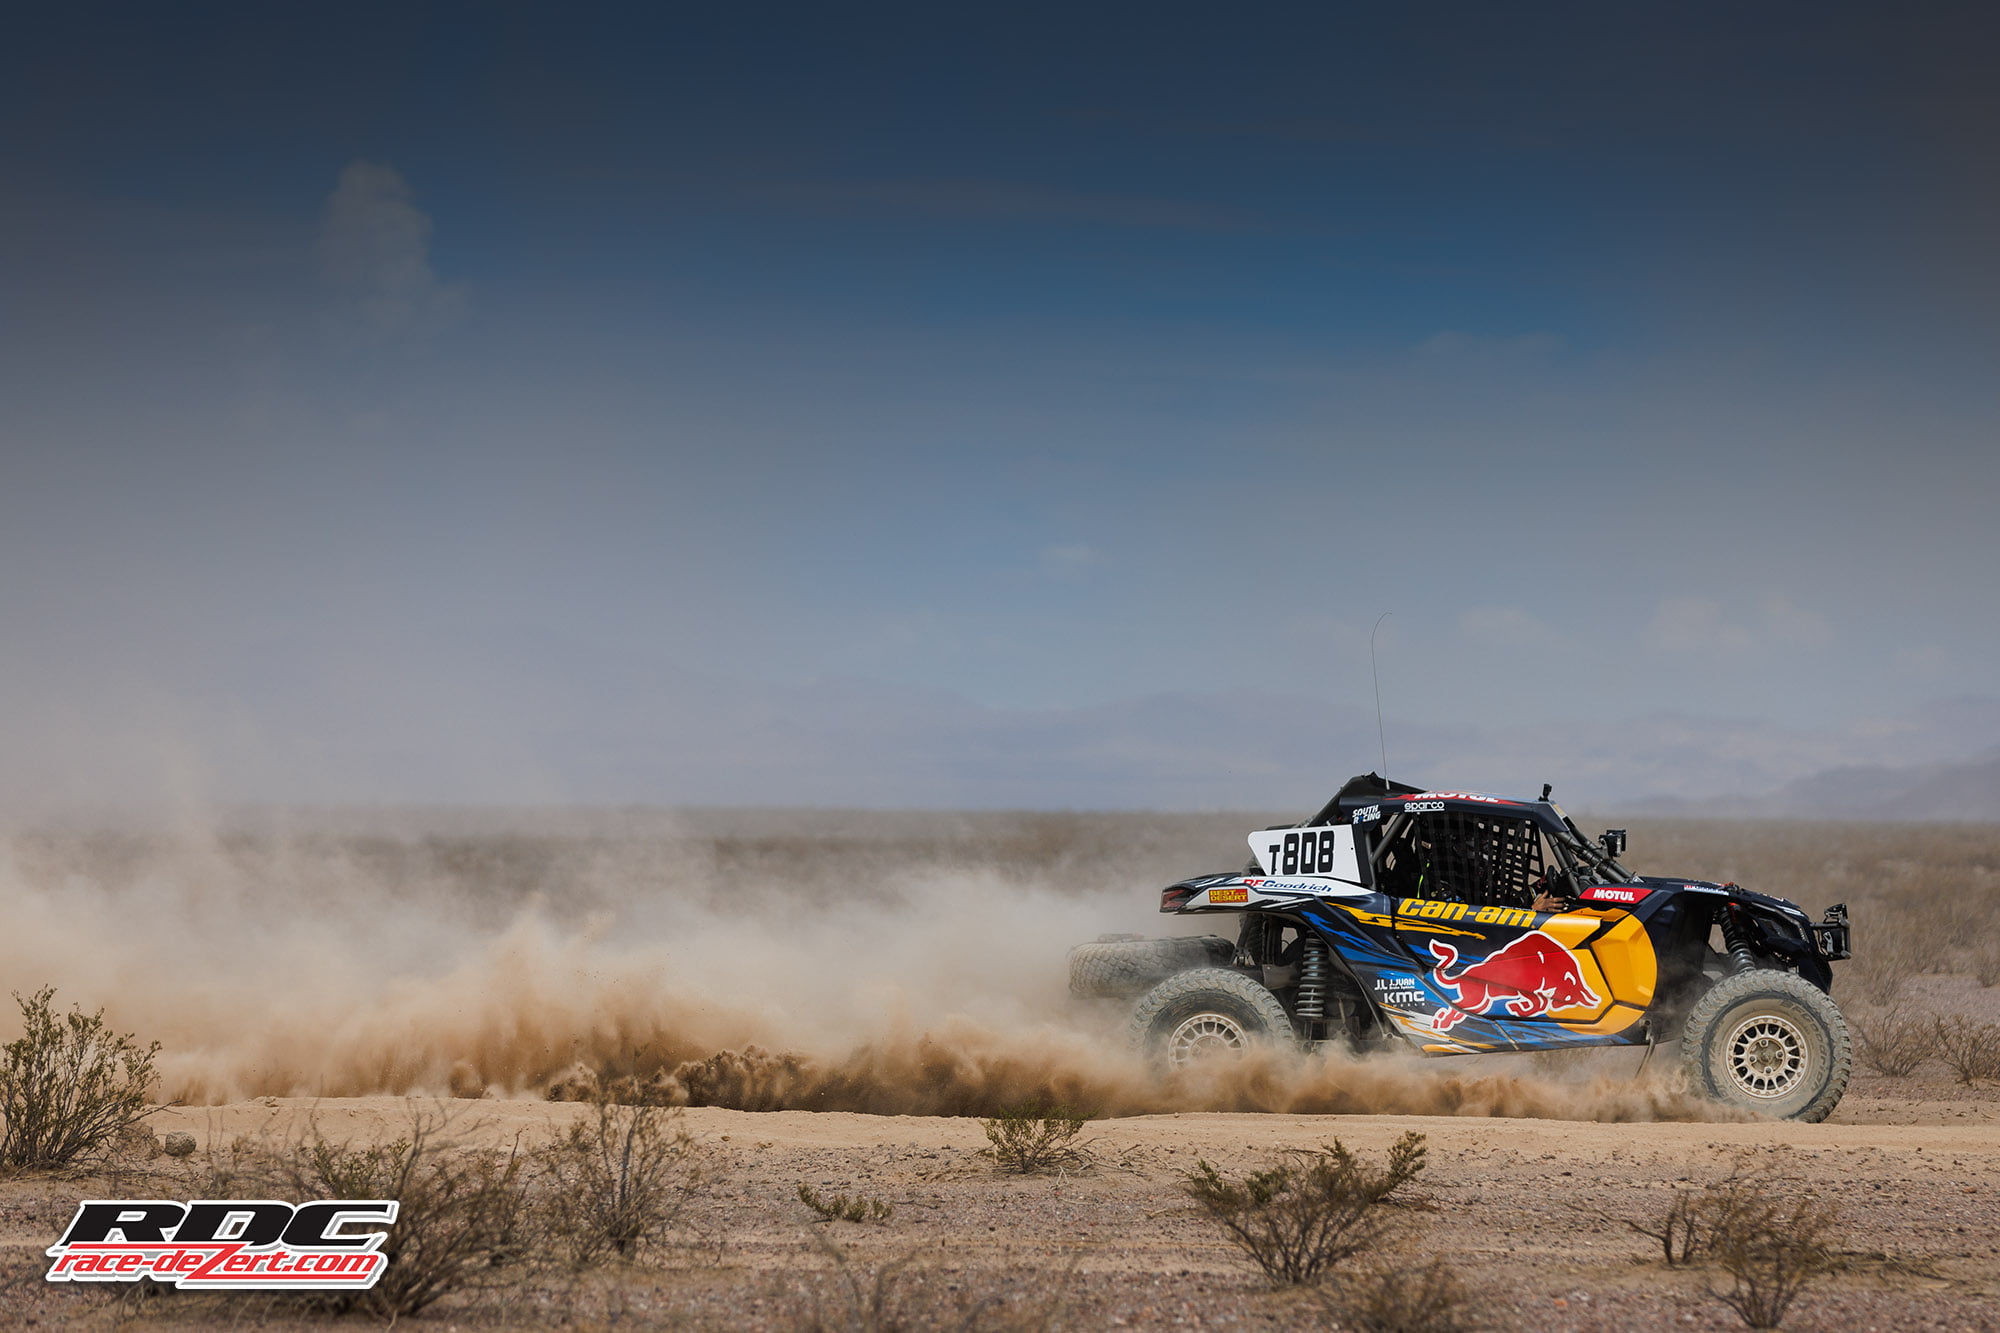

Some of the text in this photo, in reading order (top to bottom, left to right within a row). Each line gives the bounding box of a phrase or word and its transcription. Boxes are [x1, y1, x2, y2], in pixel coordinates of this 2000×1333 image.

[1352, 804, 1379, 818] SOUTH
[1404, 801, 1445, 811] sparco
[1593, 889, 1635, 901] MOTUL
[1384, 991, 1425, 1003] KMC
